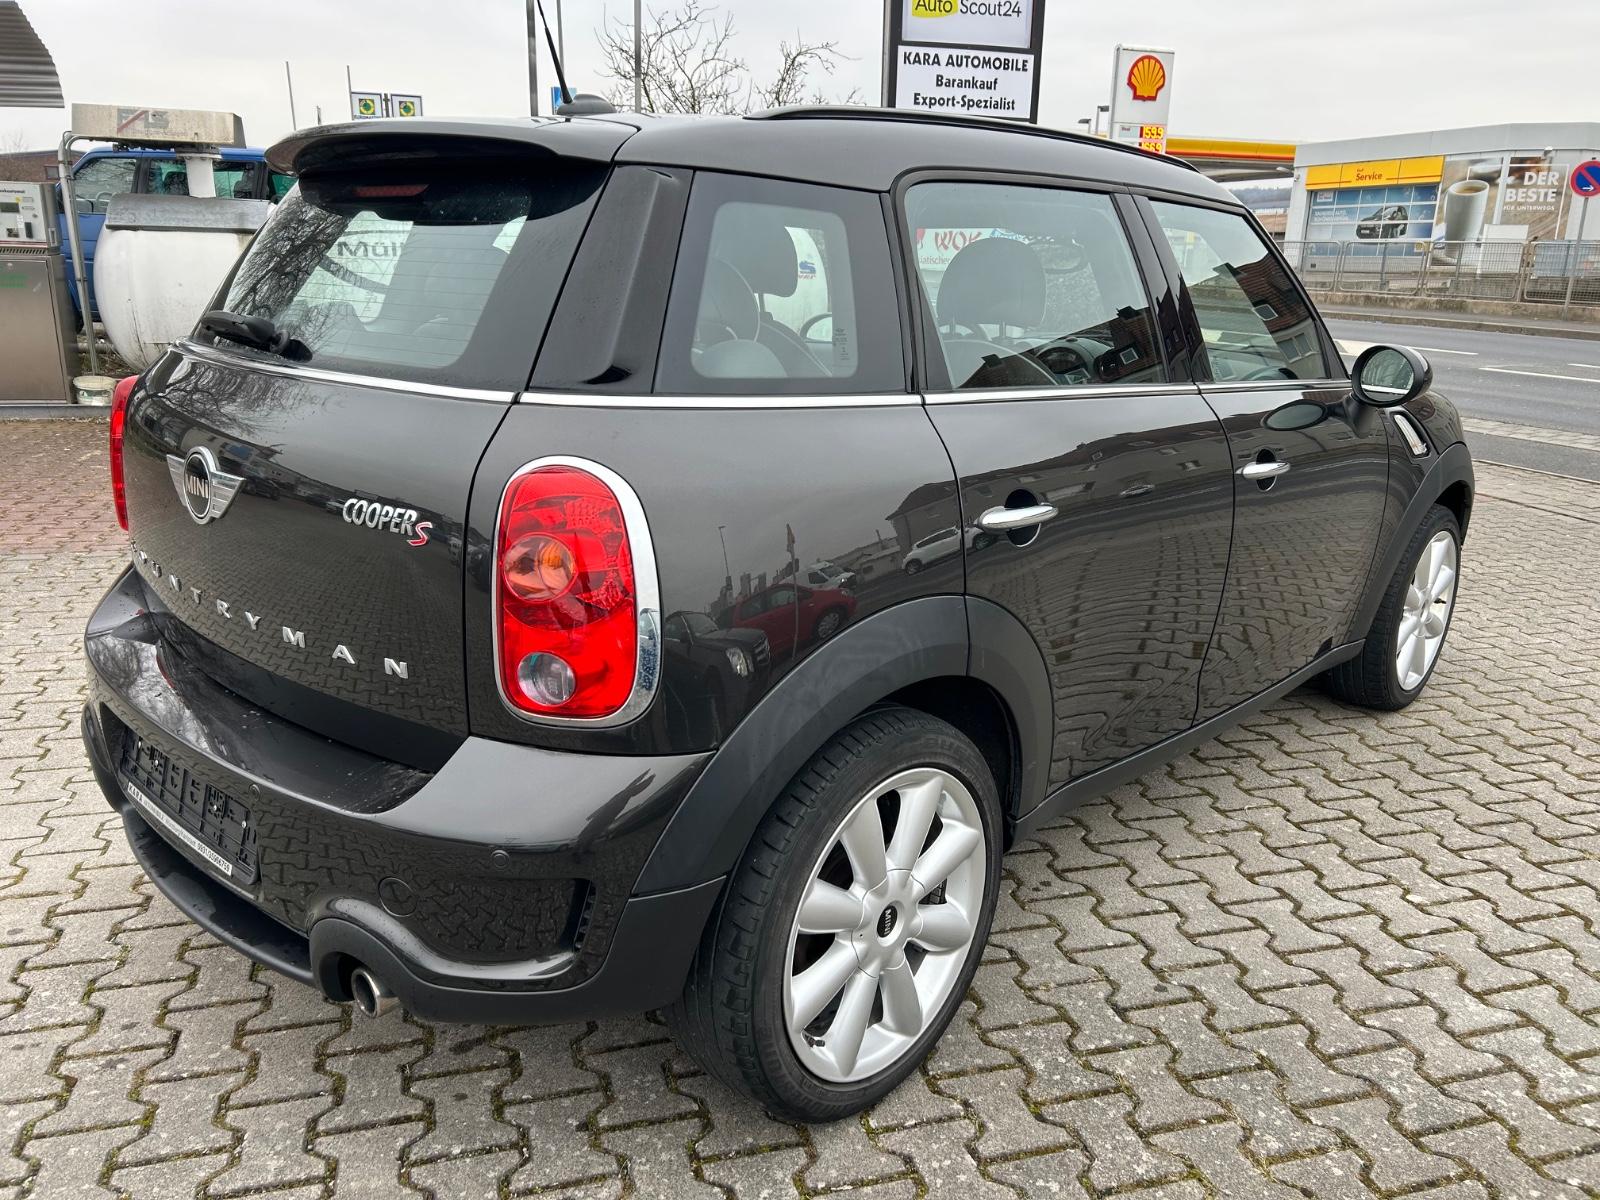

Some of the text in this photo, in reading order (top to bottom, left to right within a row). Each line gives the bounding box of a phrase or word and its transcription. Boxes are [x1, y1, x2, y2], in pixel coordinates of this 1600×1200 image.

[915, 0, 953, 12] Auto
[903, 51, 1029, 72] KARA AUTOMOBILE
[936, 74, 998, 90] Barankauf
[913, 92, 1016, 111] Export-Spezialist
[1356, 172, 1383, 181] Service
[1523, 171, 1560, 186] DER
[1505, 188, 1558, 203] BESTE
[185, 473, 209, 499] MINI
[343, 498, 433, 546] COOPER S
[884, 908, 892, 935] MINI
